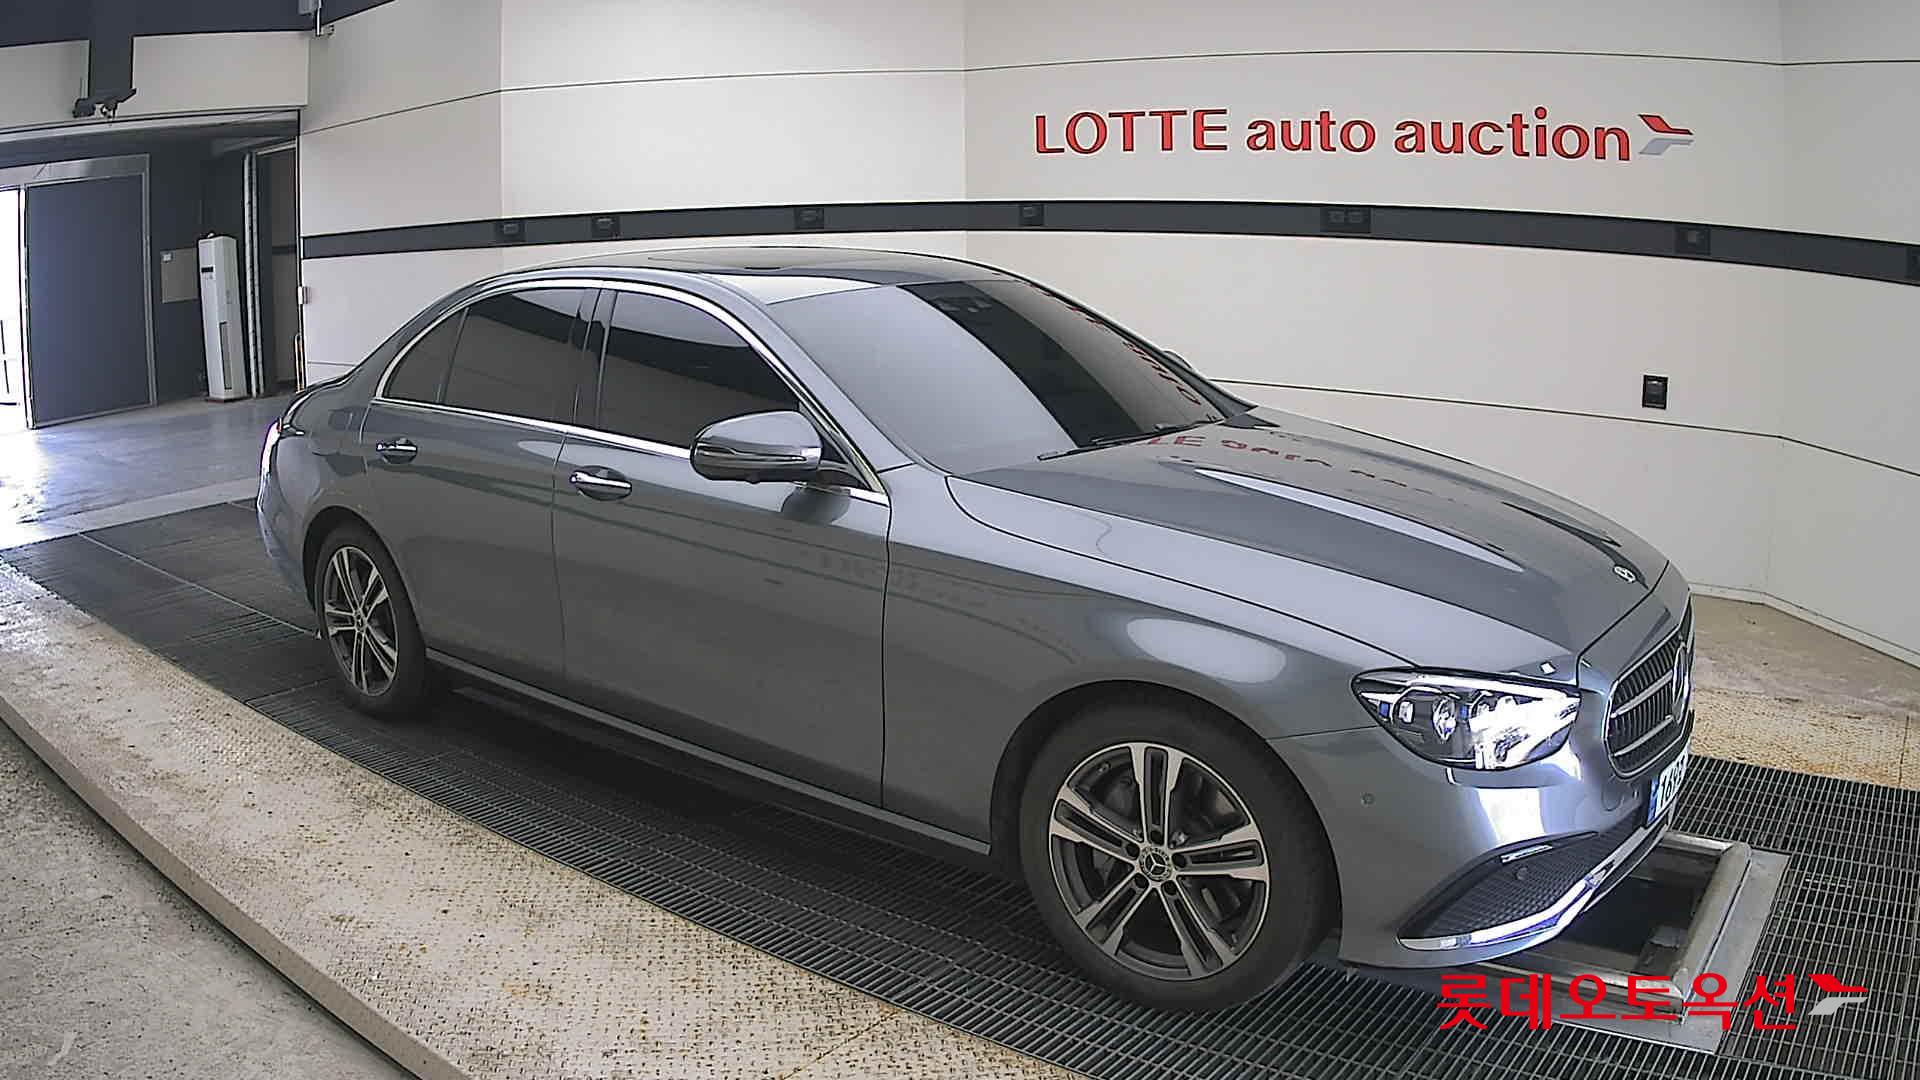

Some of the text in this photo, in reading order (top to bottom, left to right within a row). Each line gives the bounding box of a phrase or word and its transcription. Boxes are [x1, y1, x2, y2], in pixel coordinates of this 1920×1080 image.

[1035, 106, 1631, 161] LOTTE auto auction
